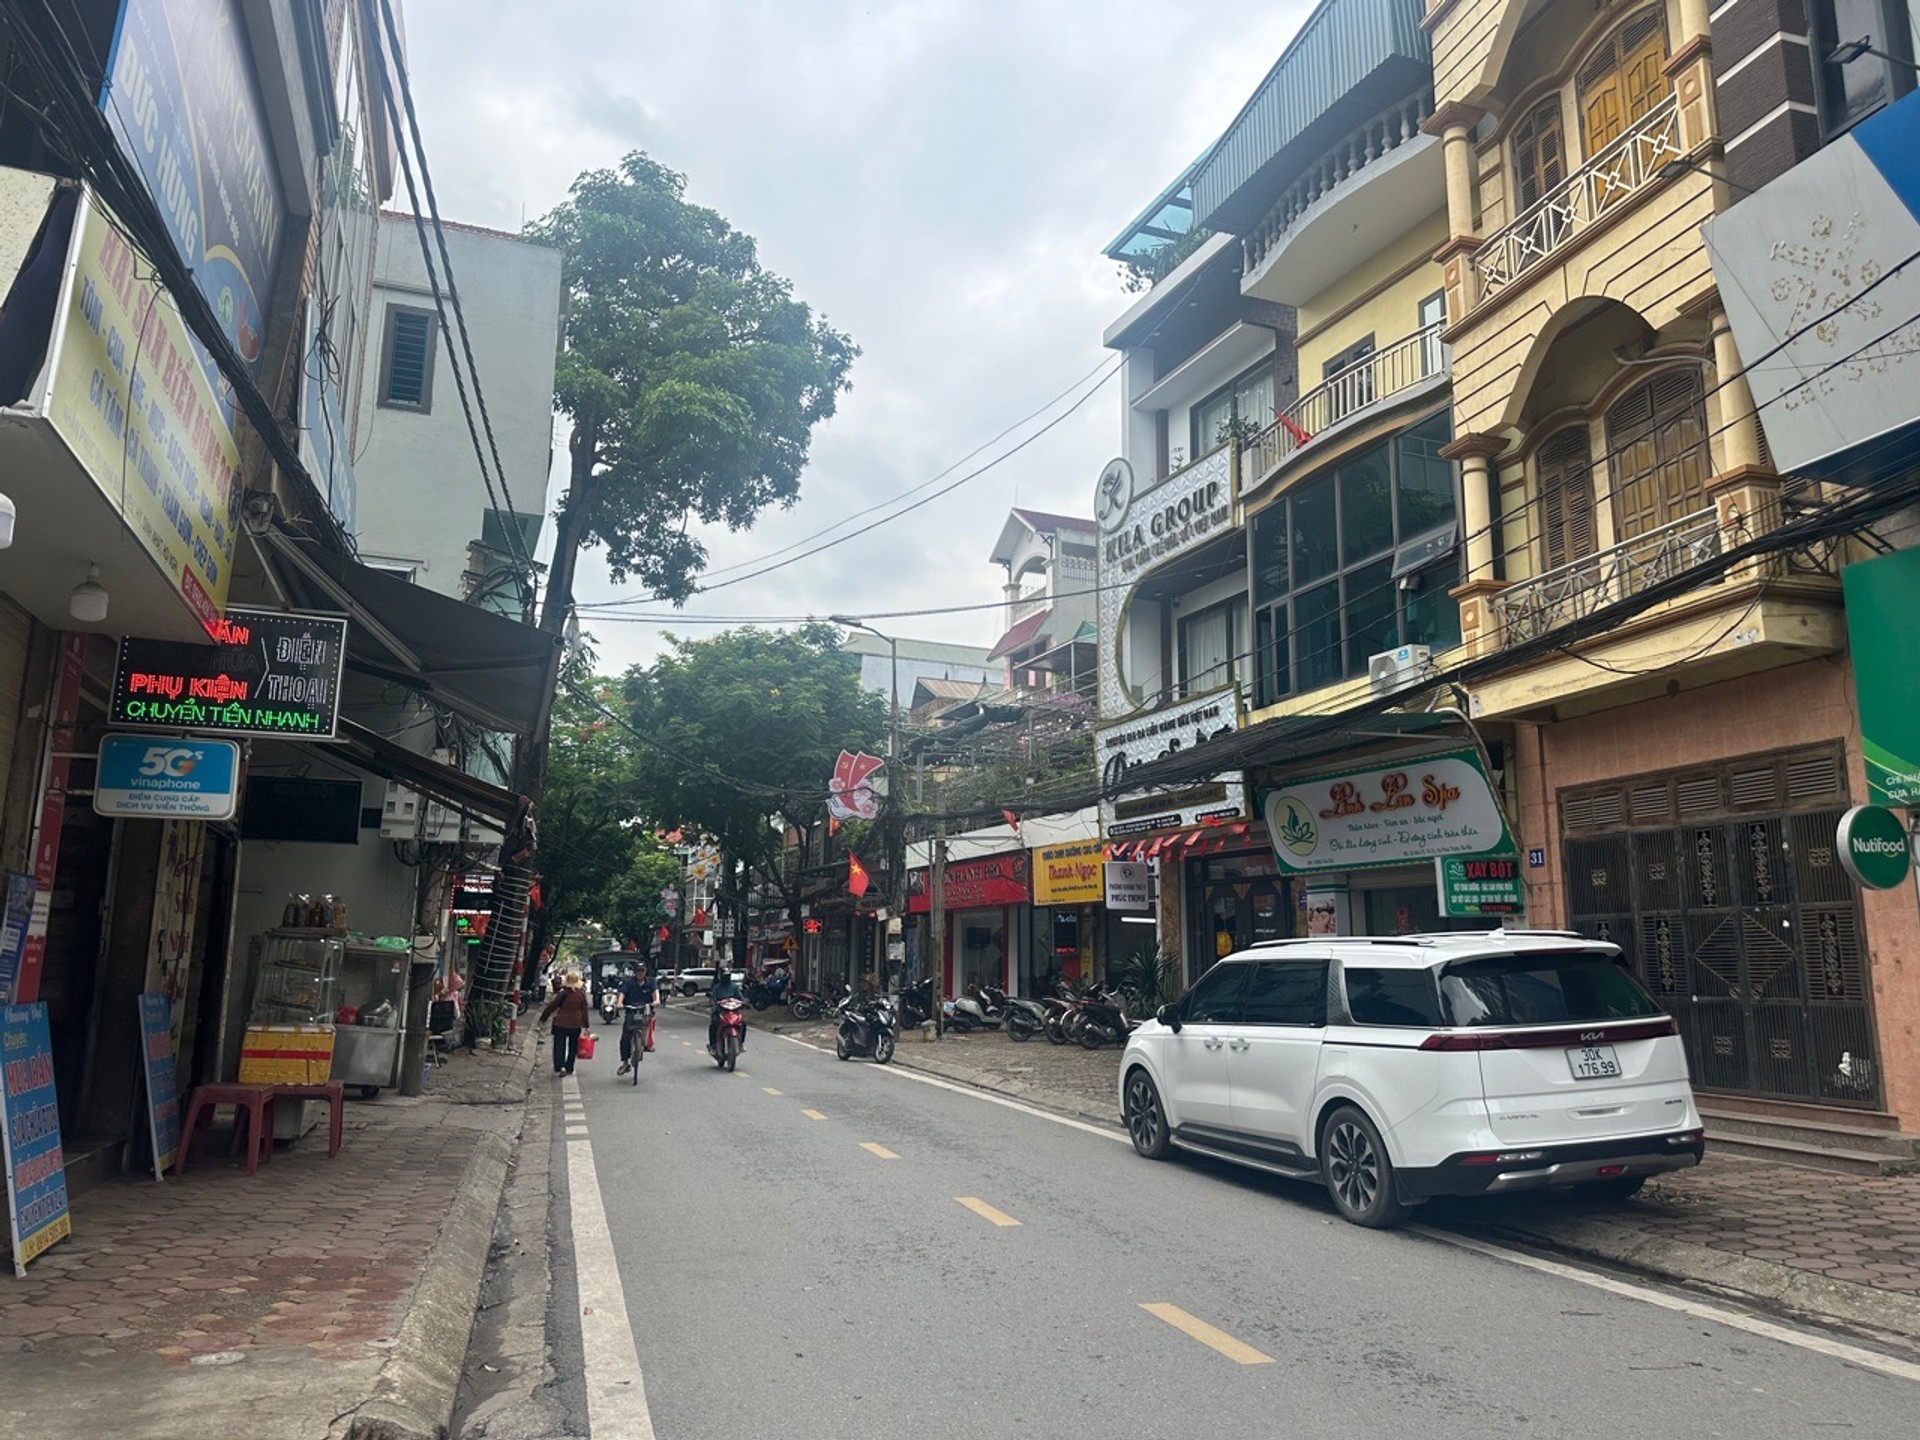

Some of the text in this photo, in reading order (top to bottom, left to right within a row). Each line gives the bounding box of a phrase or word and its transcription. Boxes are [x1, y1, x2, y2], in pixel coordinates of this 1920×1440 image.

[1151, 481, 1218, 538] GROUP
[130, 673, 248, 704] PHỤ KIỆN
[268, 674, 328, 710] THOẠI
[127, 698, 320, 729] CHUYỂN TIỀN NHANH
[131, 777, 201, 790] vinaphone
[153, 794, 179, 802] CUNG
[181, 793, 201, 802] CẤP
[1421, 774, 1461, 811] Spa
[179, 803, 210, 812] THÔNG
[1853, 838, 1904, 852] Nutifood
[1530, 852, 1544, 864] 31
[1048, 861, 1098, 882] Thanh Ngọc
[1466, 863, 1487, 878] XAY
[1581, 1048, 1603, 1062] 30K
[1578, 1062, 1616, 1076] 176.99
